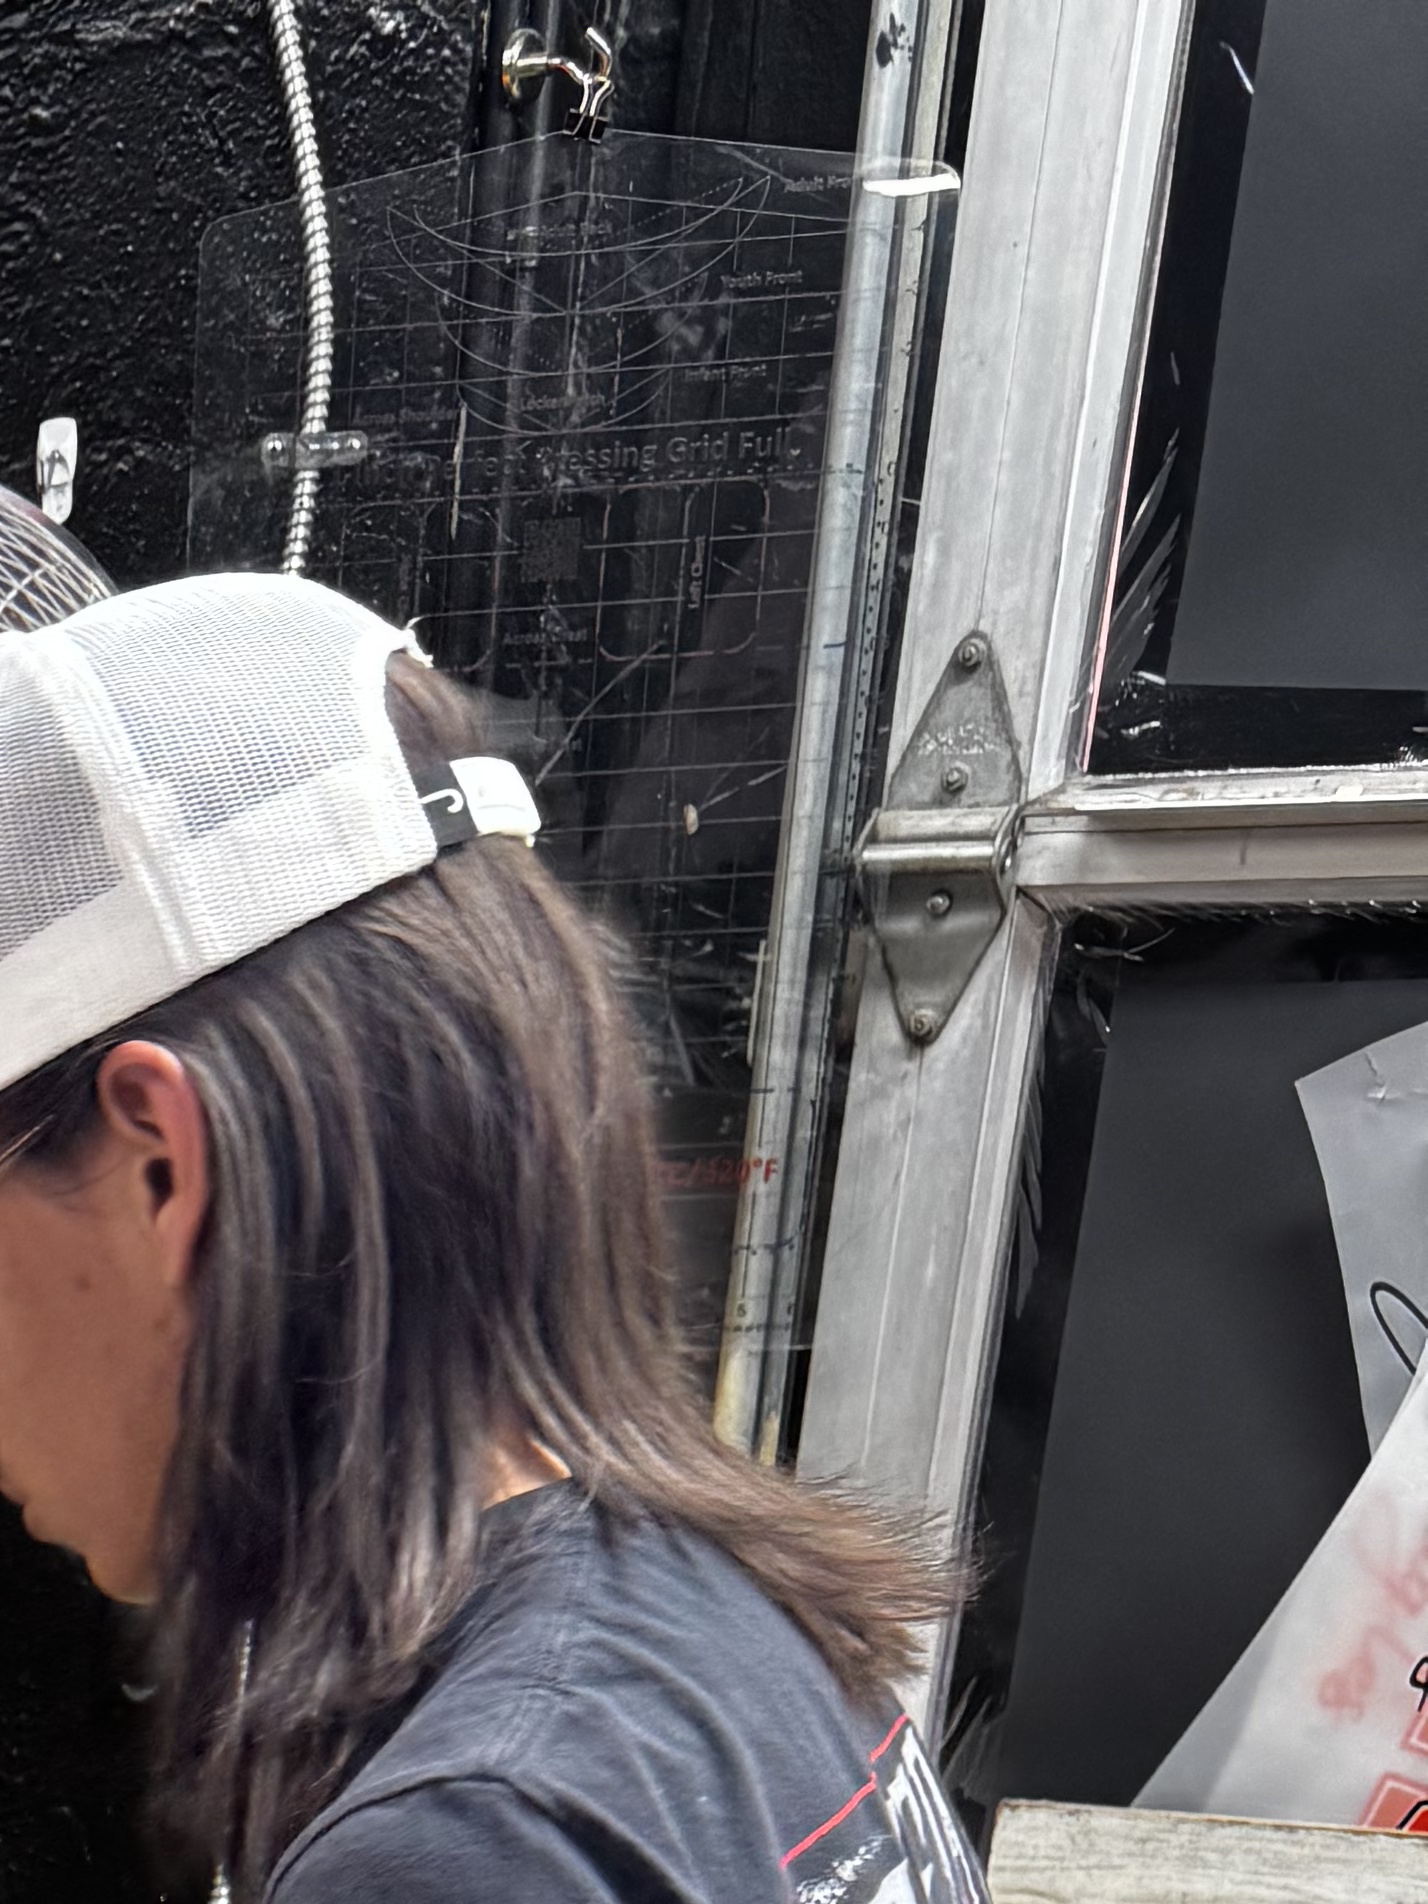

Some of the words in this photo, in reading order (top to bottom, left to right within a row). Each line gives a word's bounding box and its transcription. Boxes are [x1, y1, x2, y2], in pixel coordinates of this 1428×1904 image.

[720, 272, 762, 289] Youth
[765, 269, 804, 287] Front
[666, 430, 730, 463] Grid
